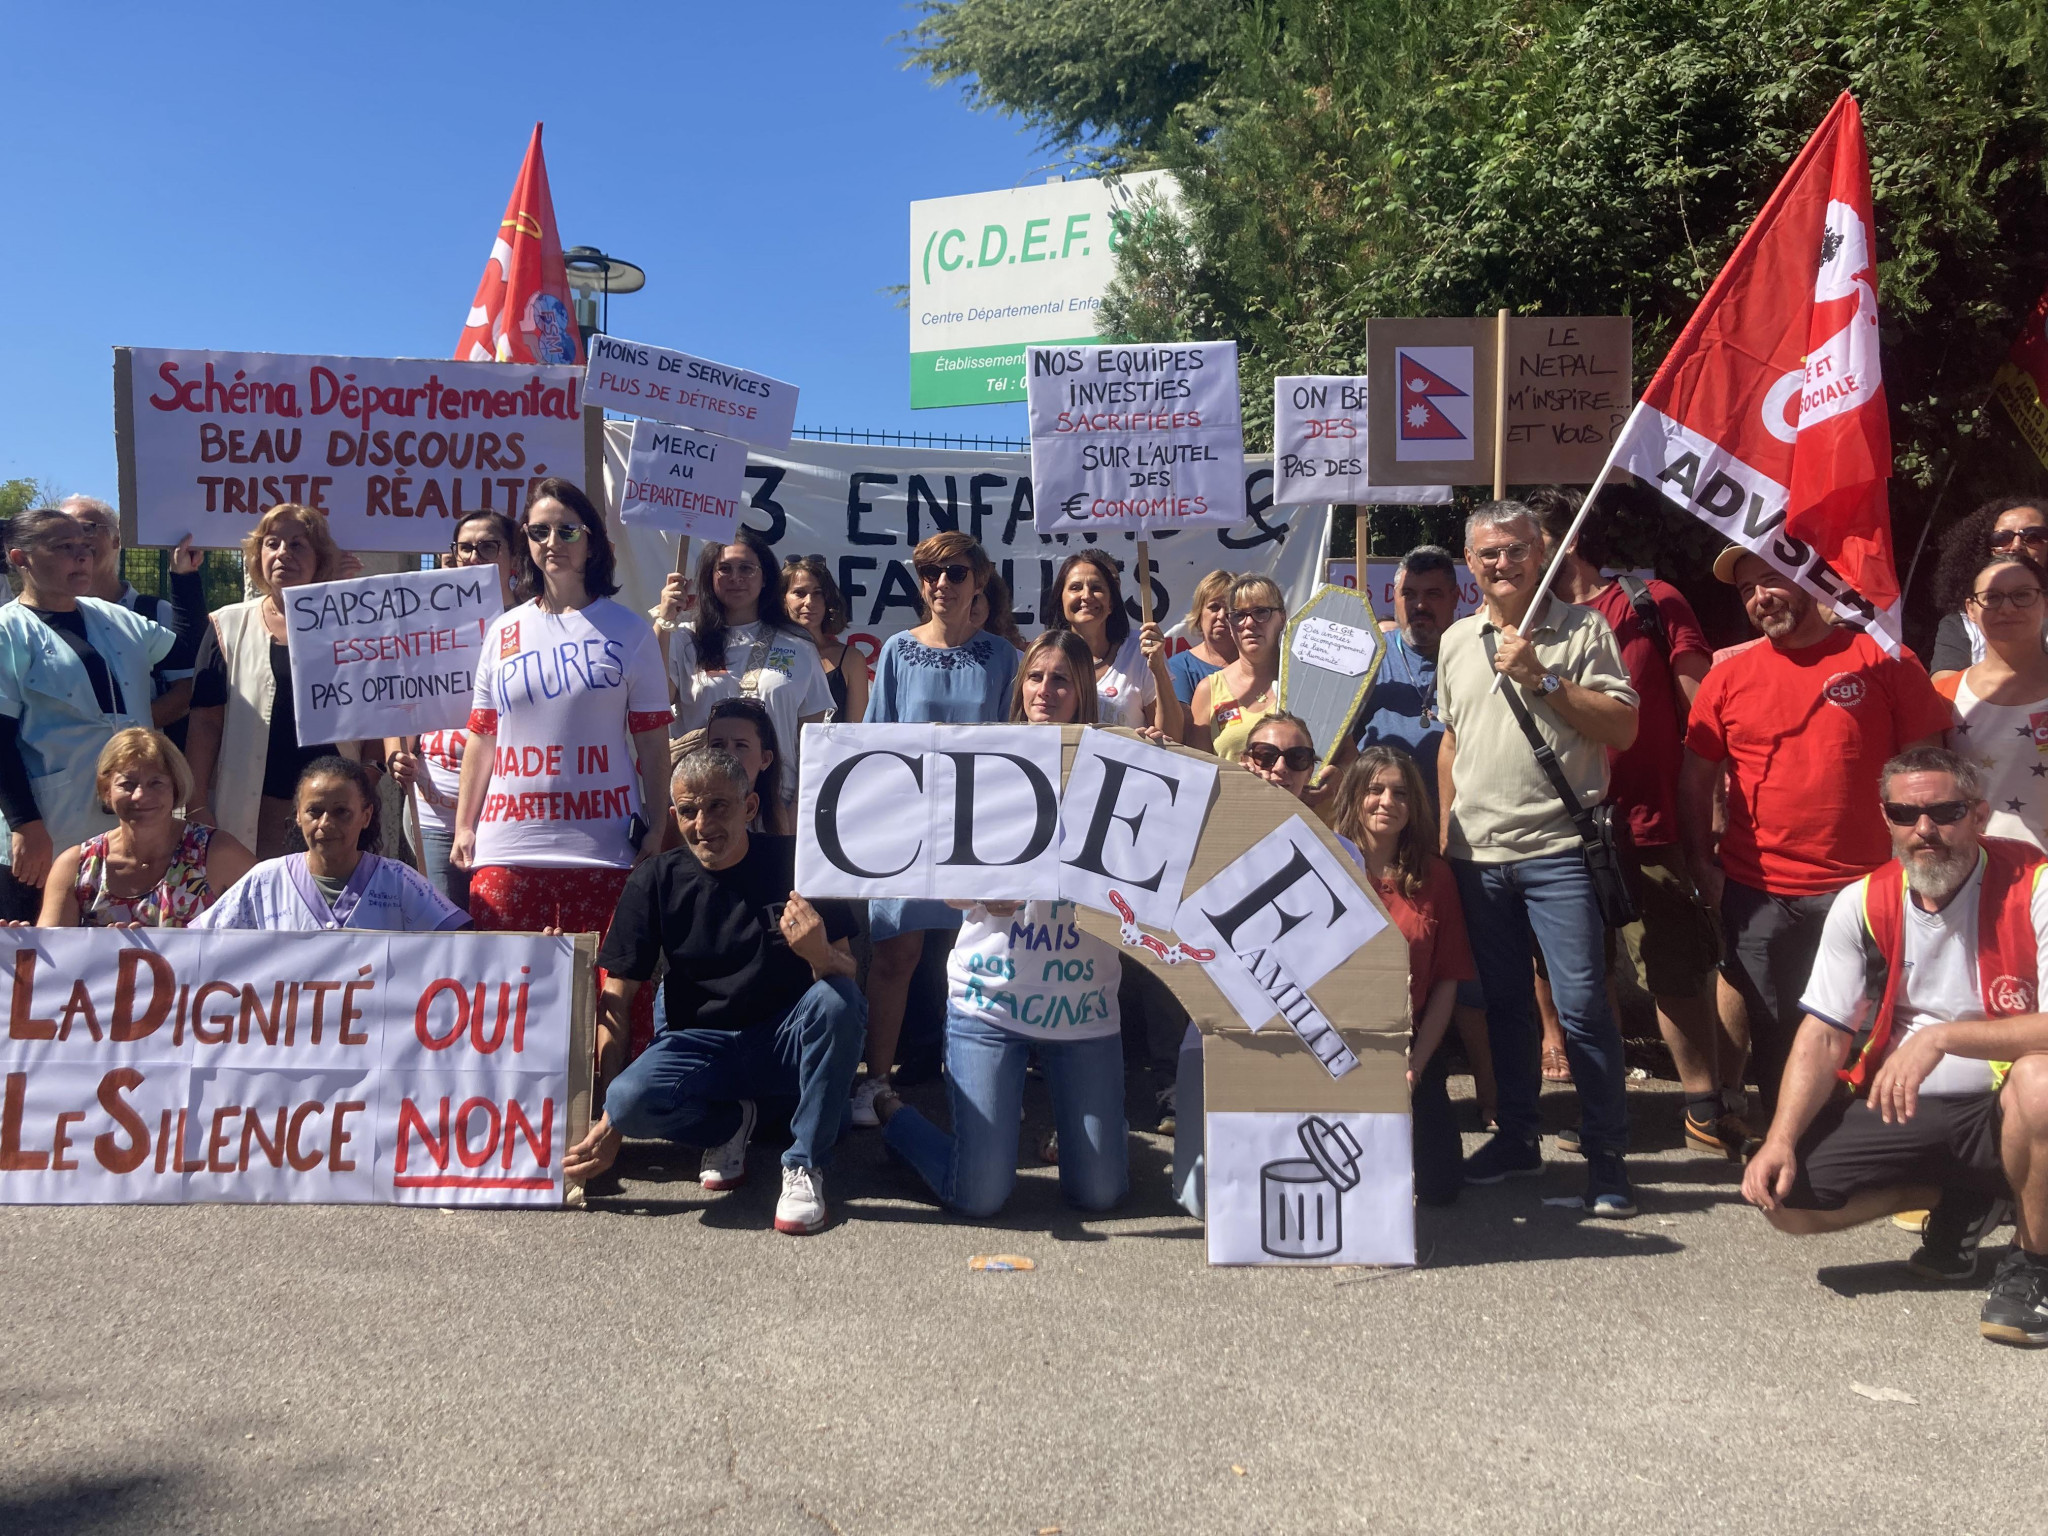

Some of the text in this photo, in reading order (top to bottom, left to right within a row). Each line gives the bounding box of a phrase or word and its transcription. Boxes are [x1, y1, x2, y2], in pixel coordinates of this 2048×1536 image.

[923, 213, 1091, 285] (C.D.E.F.
[922, 311, 963, 326] Centre
[967, 299, 1065, 322] Départemental
[1548, 327, 1580, 346] LE
[597, 339, 770, 398] MOINS DE SERVICES
[1034, 348, 1204, 377] NOS EQUIPES
[1520, 353, 1618, 377] NEPAL
[1815, 355, 1832, 377] ET
[599, 372, 757, 420] PLUS DE DÉTRESSE
[987, 377, 1008, 391] Tél
[1070, 379, 1191, 407] INVESTIES
[1293, 386, 1328, 410] ON
[1799, 374, 1860, 415] SOCIALE
[310, 366, 581, 431] Départemental
[1055, 406, 1202, 432] SACRIFIÉES
[1303, 418, 1357, 439] DES
[1507, 423, 1546, 442] ET
[200, 423, 526, 471] BEAU DISCOURS
[652, 433, 718, 462] MERCI
[1082, 443, 1218, 471] SUR L'AUTEL
[669, 464, 693, 479] AU
[1129, 471, 1171, 487] DES
[1280, 454, 1362, 478] PAS DES
[197, 474, 333, 516] TRISTE
[625, 477, 738, 518] DÉPARTEMENT
[333, 625, 469, 665] ESSENTIEL
[503, 637, 517, 650] cgt
[311, 671, 473, 709] PAS OPTIONNEL
[1830, 682, 1859, 699] cgt
[1217, 708, 1240, 722] cgt
[578, 745, 609, 774] IN
[1009, 921, 1080, 951] MAIS
[1042, 958, 1094, 982] nos
[415, 966, 530, 1054] OUI
[965, 975, 1109, 1029] RACINES
[395, 1096, 553, 1173] NON
